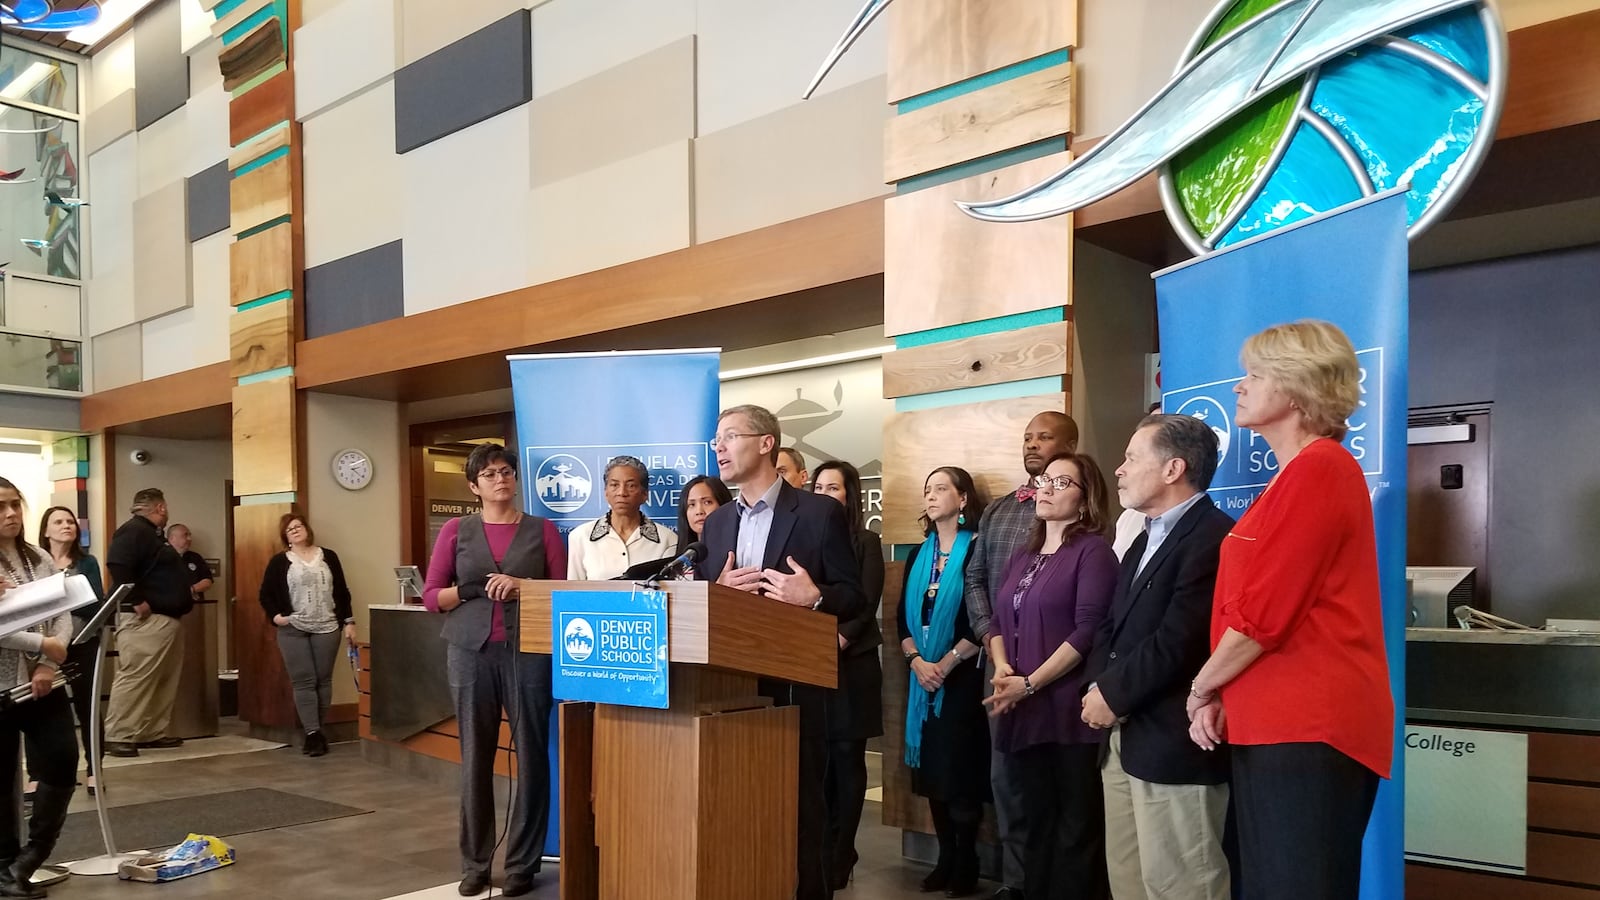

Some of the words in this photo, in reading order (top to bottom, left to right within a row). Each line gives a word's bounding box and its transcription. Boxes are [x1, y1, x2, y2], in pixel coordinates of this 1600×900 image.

[1227, 492, 1262, 509] Worl
[431, 504, 463, 514] DENVER
[600, 620, 652, 634] DENVER
[601, 634, 652, 651] PUBLIC
[601, 650, 653, 664] SCHOOLS
[561, 669, 586, 677] Discover
[592, 671, 608, 679] World
[610, 672, 617, 680] of
[1405, 733, 1476, 757] College
